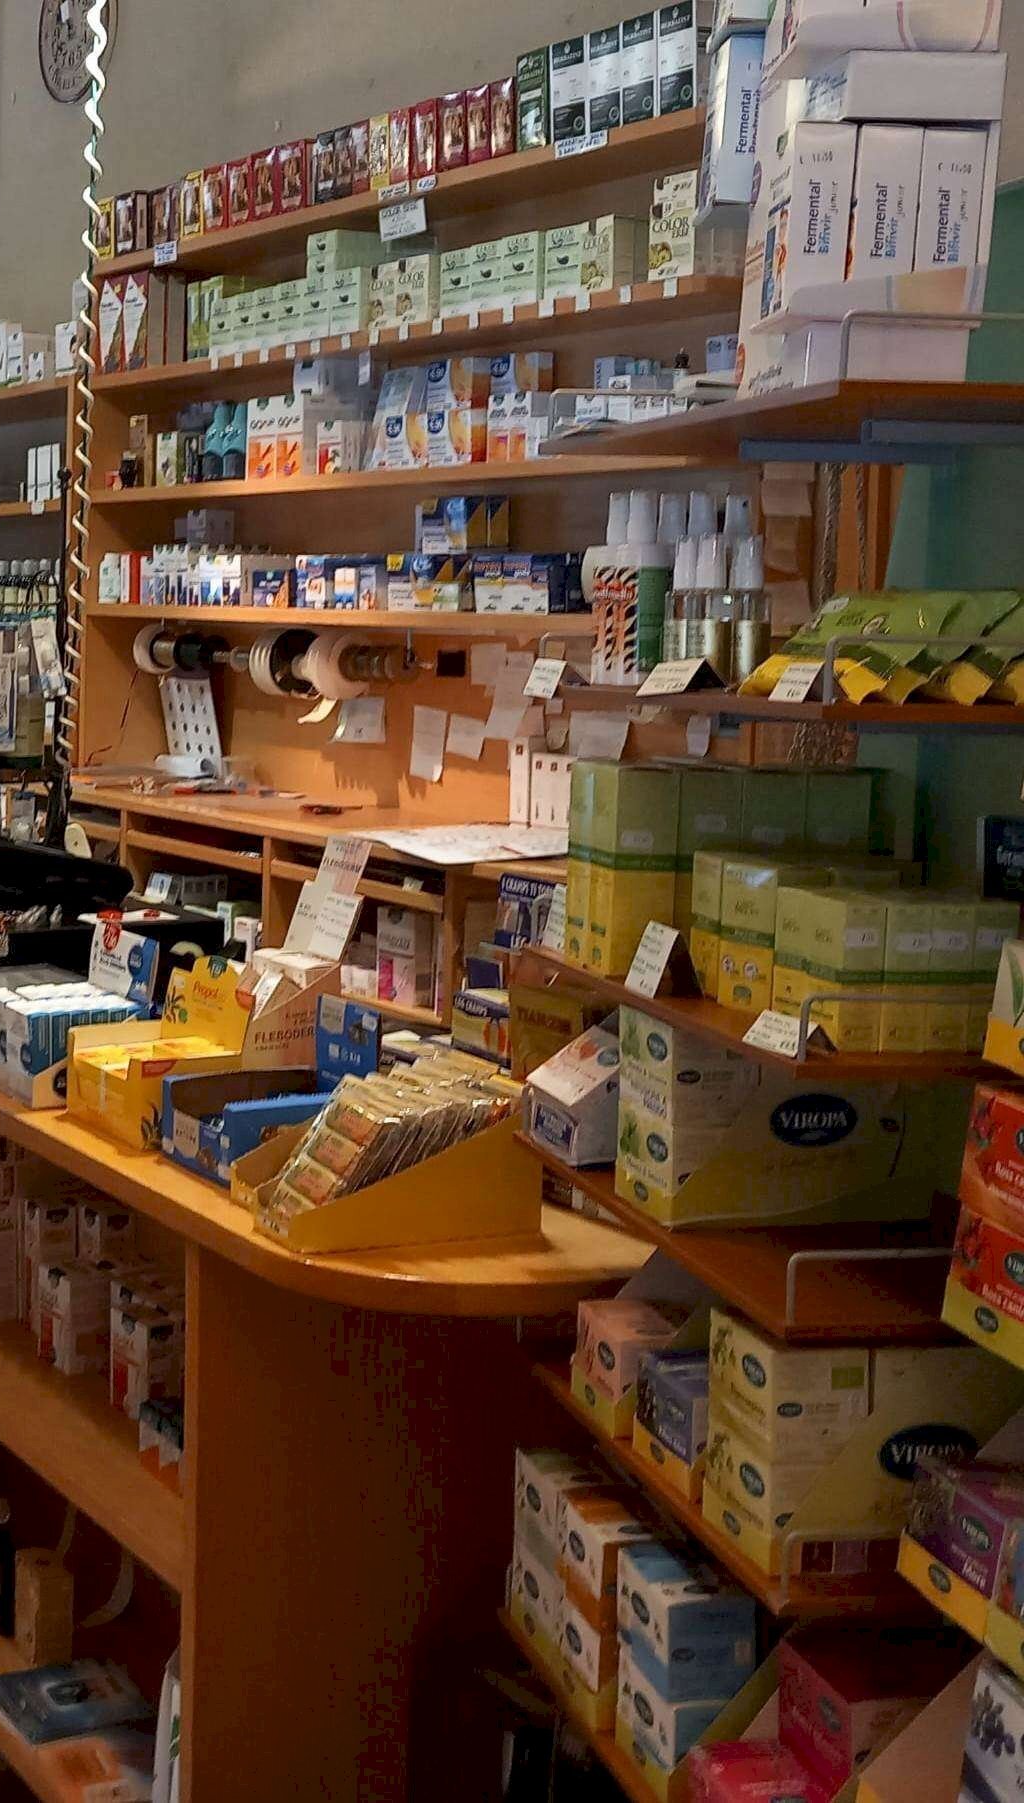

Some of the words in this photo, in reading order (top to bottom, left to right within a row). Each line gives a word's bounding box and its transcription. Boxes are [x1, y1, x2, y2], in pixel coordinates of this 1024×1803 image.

[736, 86, 752, 153] Fermental
[803, 178, 821, 254] Fermental
[870, 182, 888, 258] Fermental
[933, 187, 951, 262] Fermental
[779, 1110, 848, 1129] VIROPA
